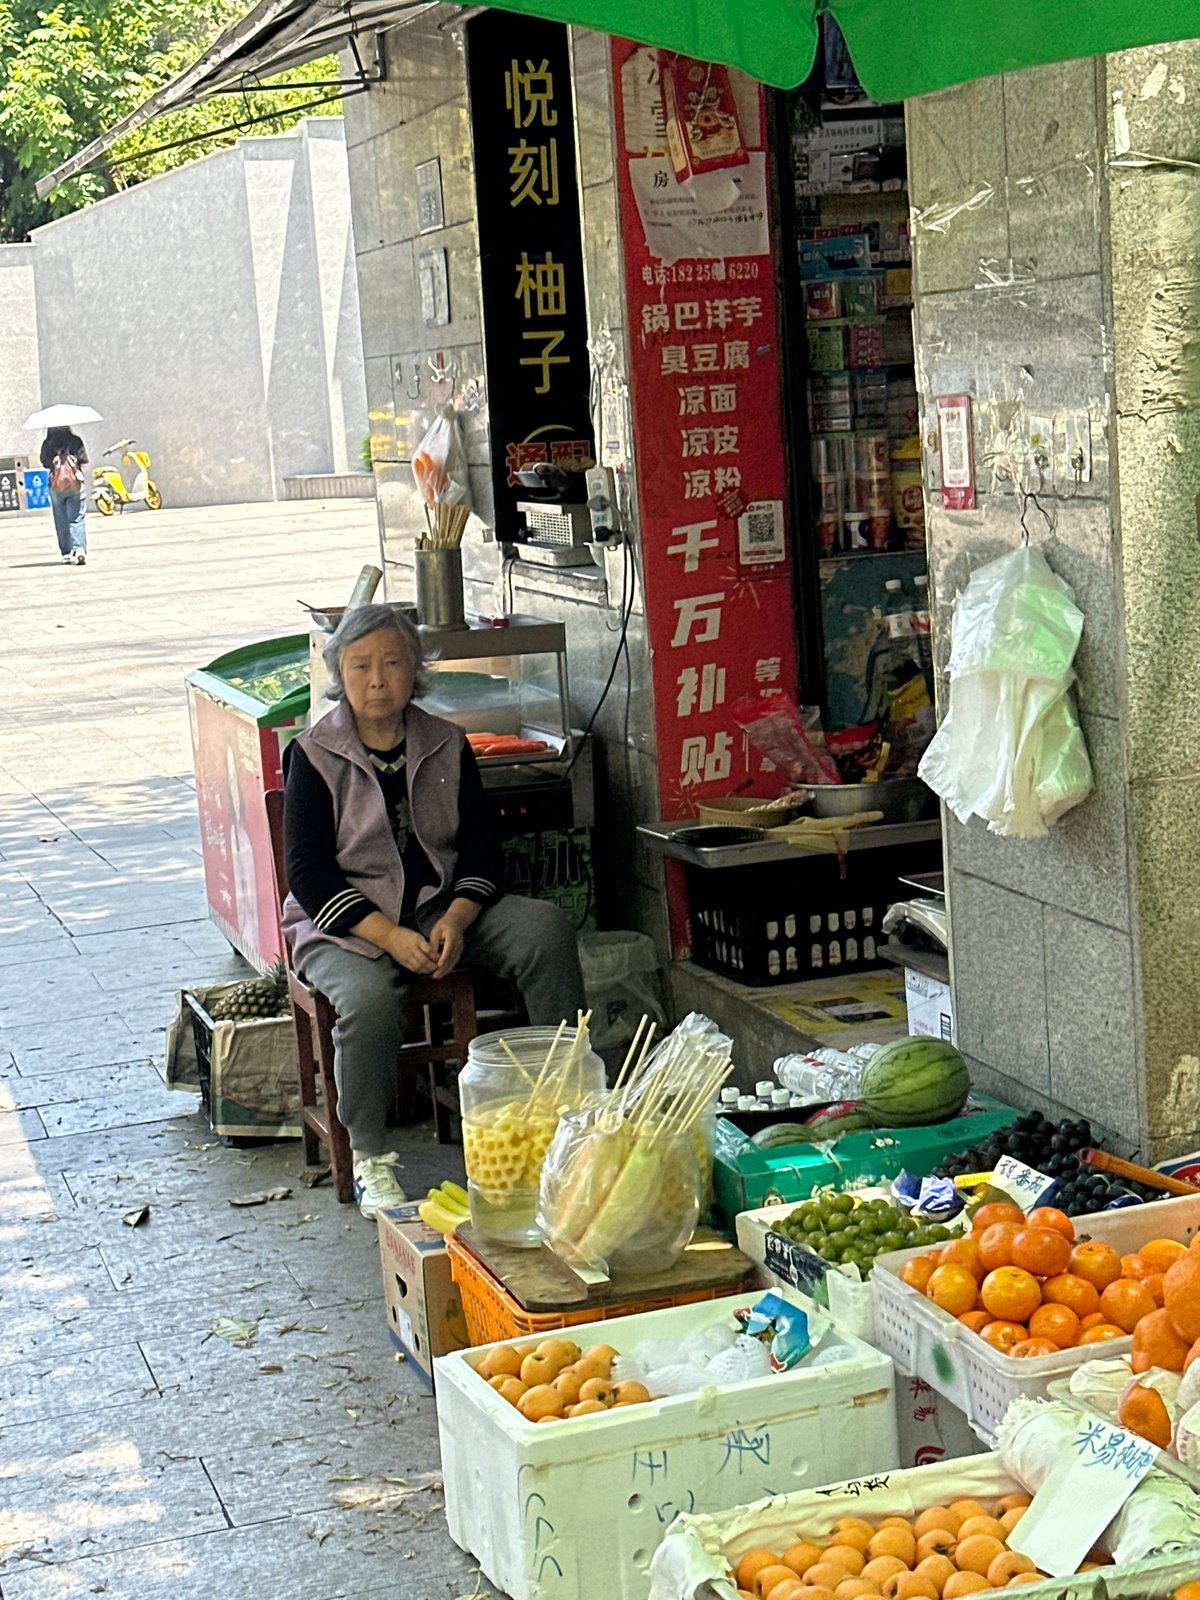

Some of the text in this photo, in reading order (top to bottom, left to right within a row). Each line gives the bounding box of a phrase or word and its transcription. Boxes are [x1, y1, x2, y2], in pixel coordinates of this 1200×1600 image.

[504, 58, 571, 395] 悦刻 柚子
[641, 296, 763, 334] 锅巴洋芋
[661, 340, 751, 375] 臭豆腐
[677, 384, 737, 416] 凉面
[681, 425, 740, 457] 凉皮
[684, 466, 742, 499] 凉粉
[666, 518, 733, 788] 千万补贴
